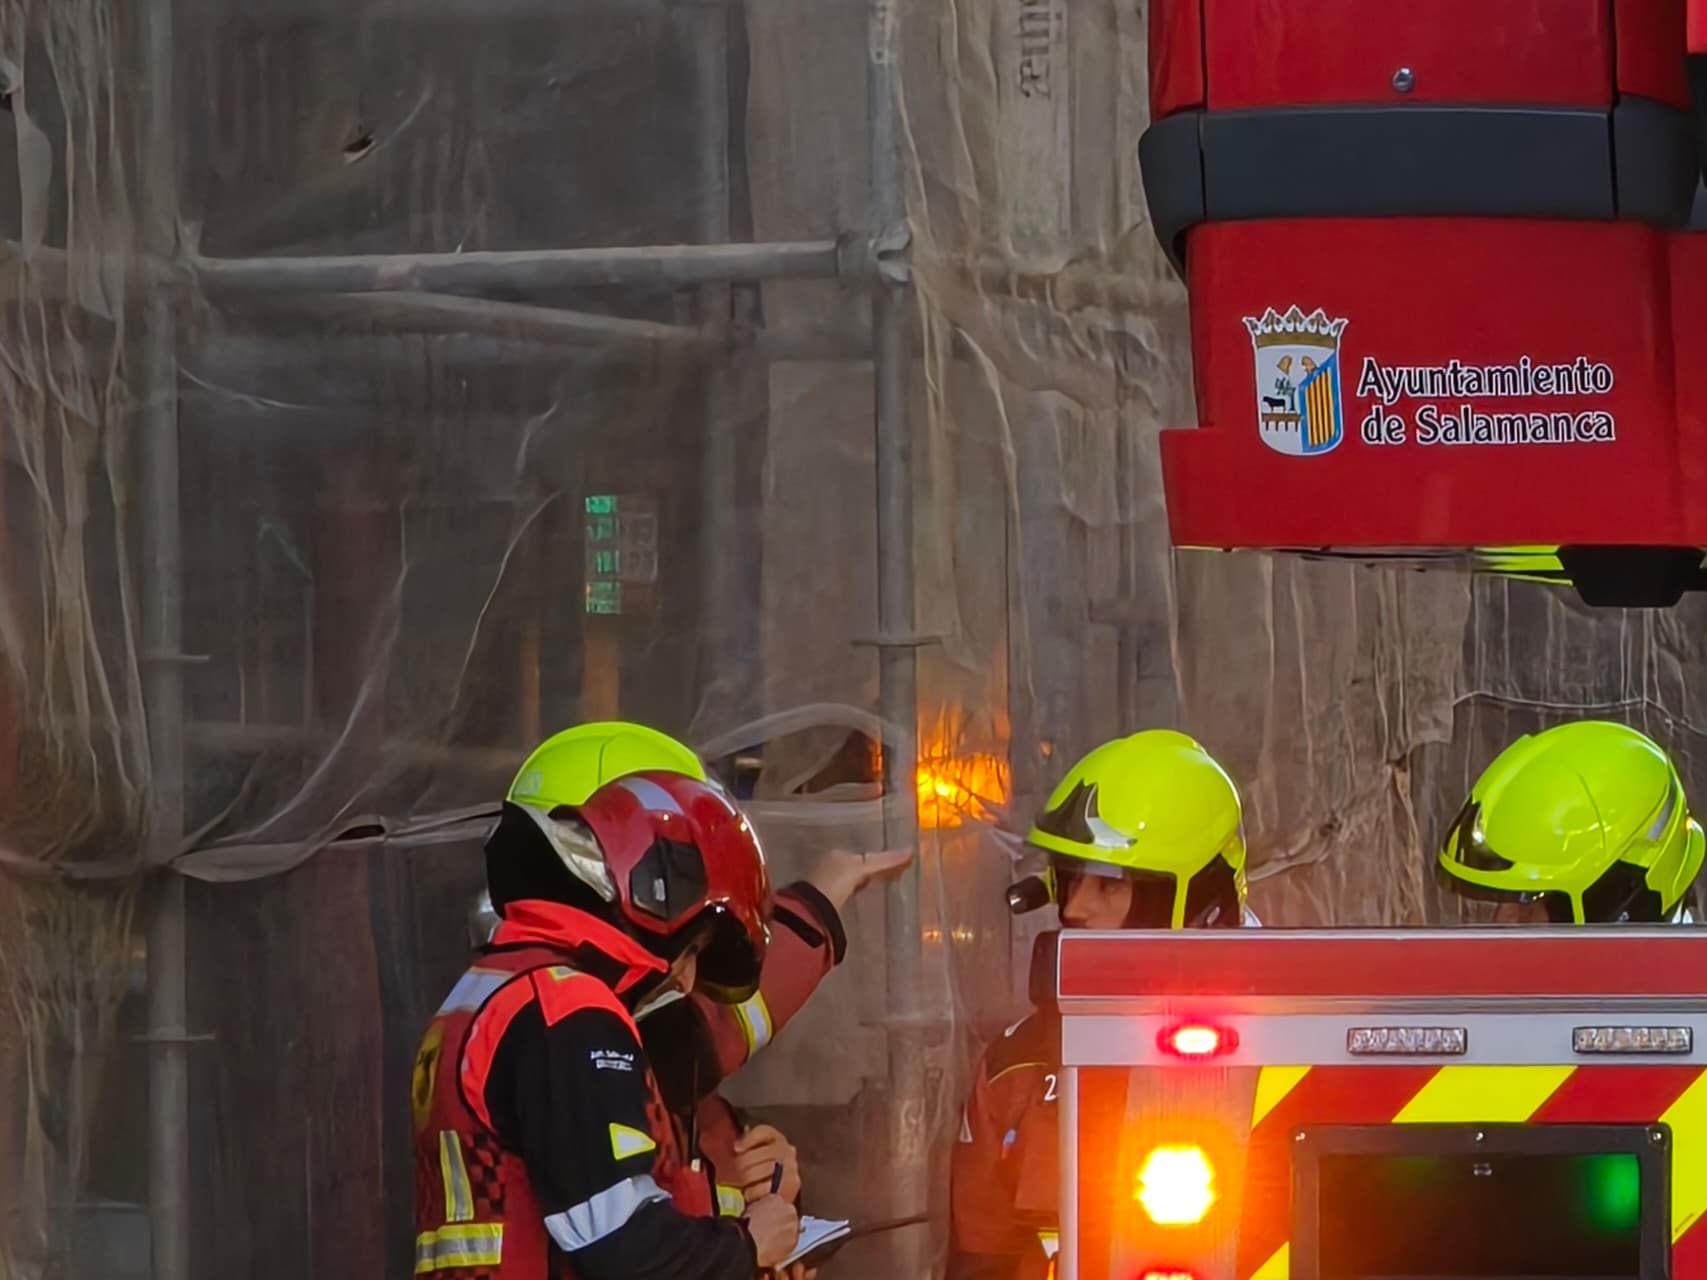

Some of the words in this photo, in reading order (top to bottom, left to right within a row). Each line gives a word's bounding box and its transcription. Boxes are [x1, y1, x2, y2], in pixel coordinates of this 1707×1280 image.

[1356, 355, 1614, 405] Ayuntamiento
[1361, 404, 1406, 444] de
[1416, 404, 1616, 444] Salamanca
